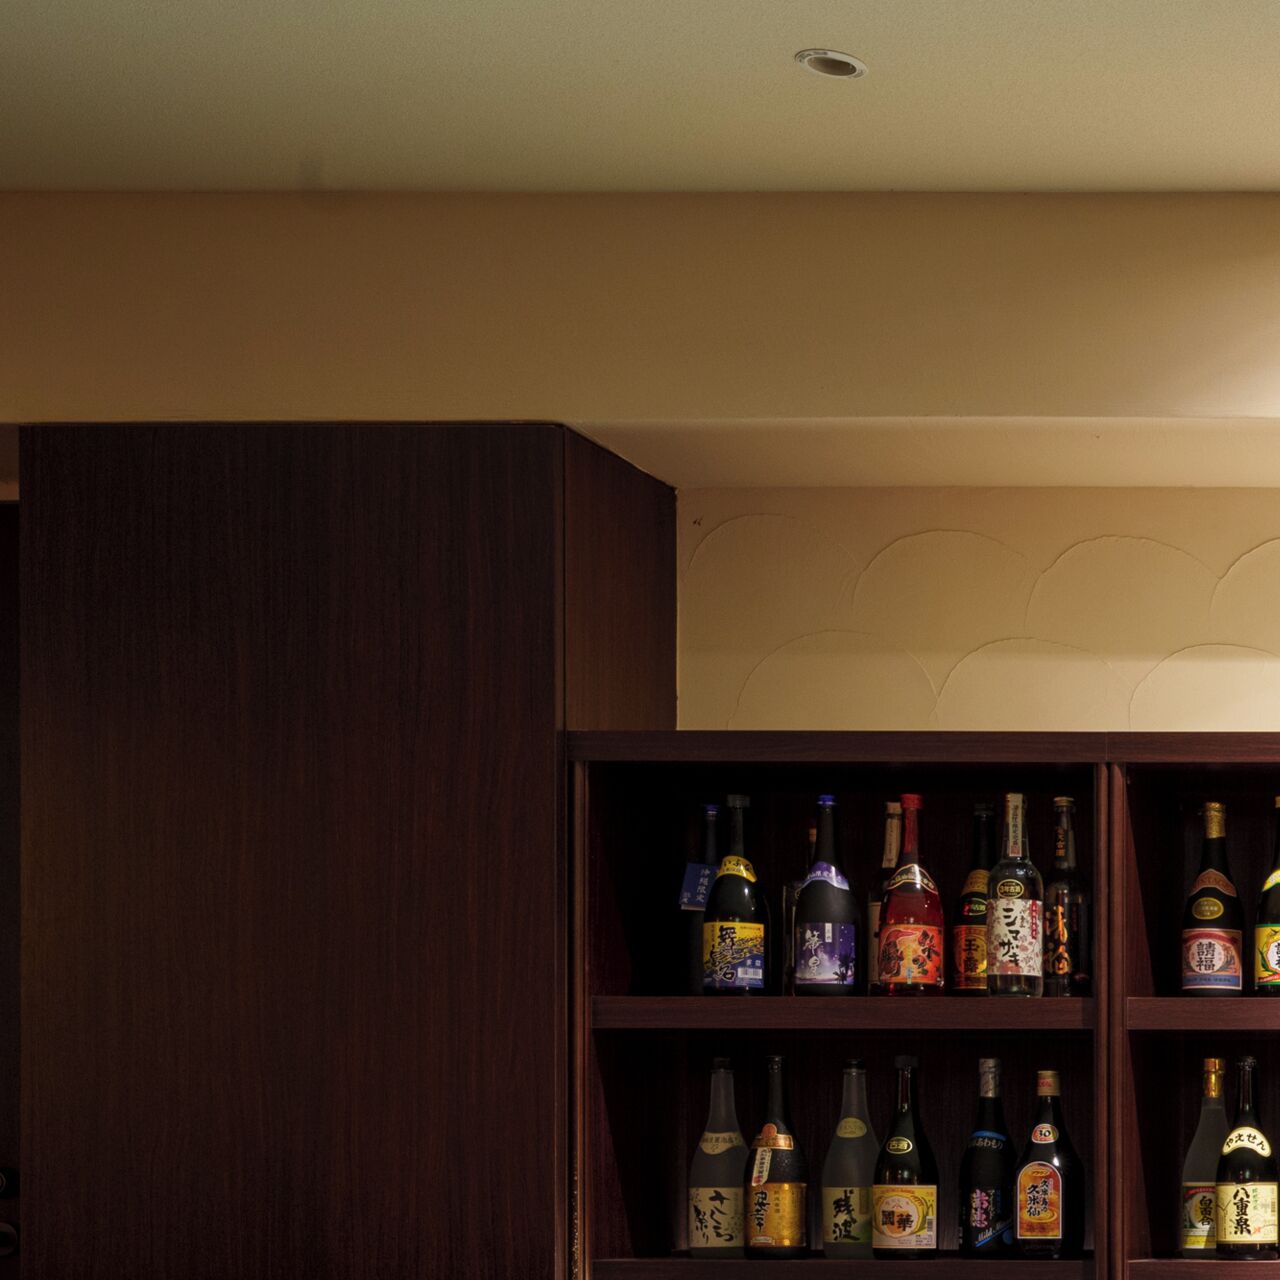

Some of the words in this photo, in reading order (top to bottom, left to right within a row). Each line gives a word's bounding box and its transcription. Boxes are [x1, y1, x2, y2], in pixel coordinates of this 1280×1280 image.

[999, 907, 1021, 966] シマザキ
[1027, 1184, 1041, 1217] 久米仙
[1233, 1187, 1251, 1235] 八重泉
